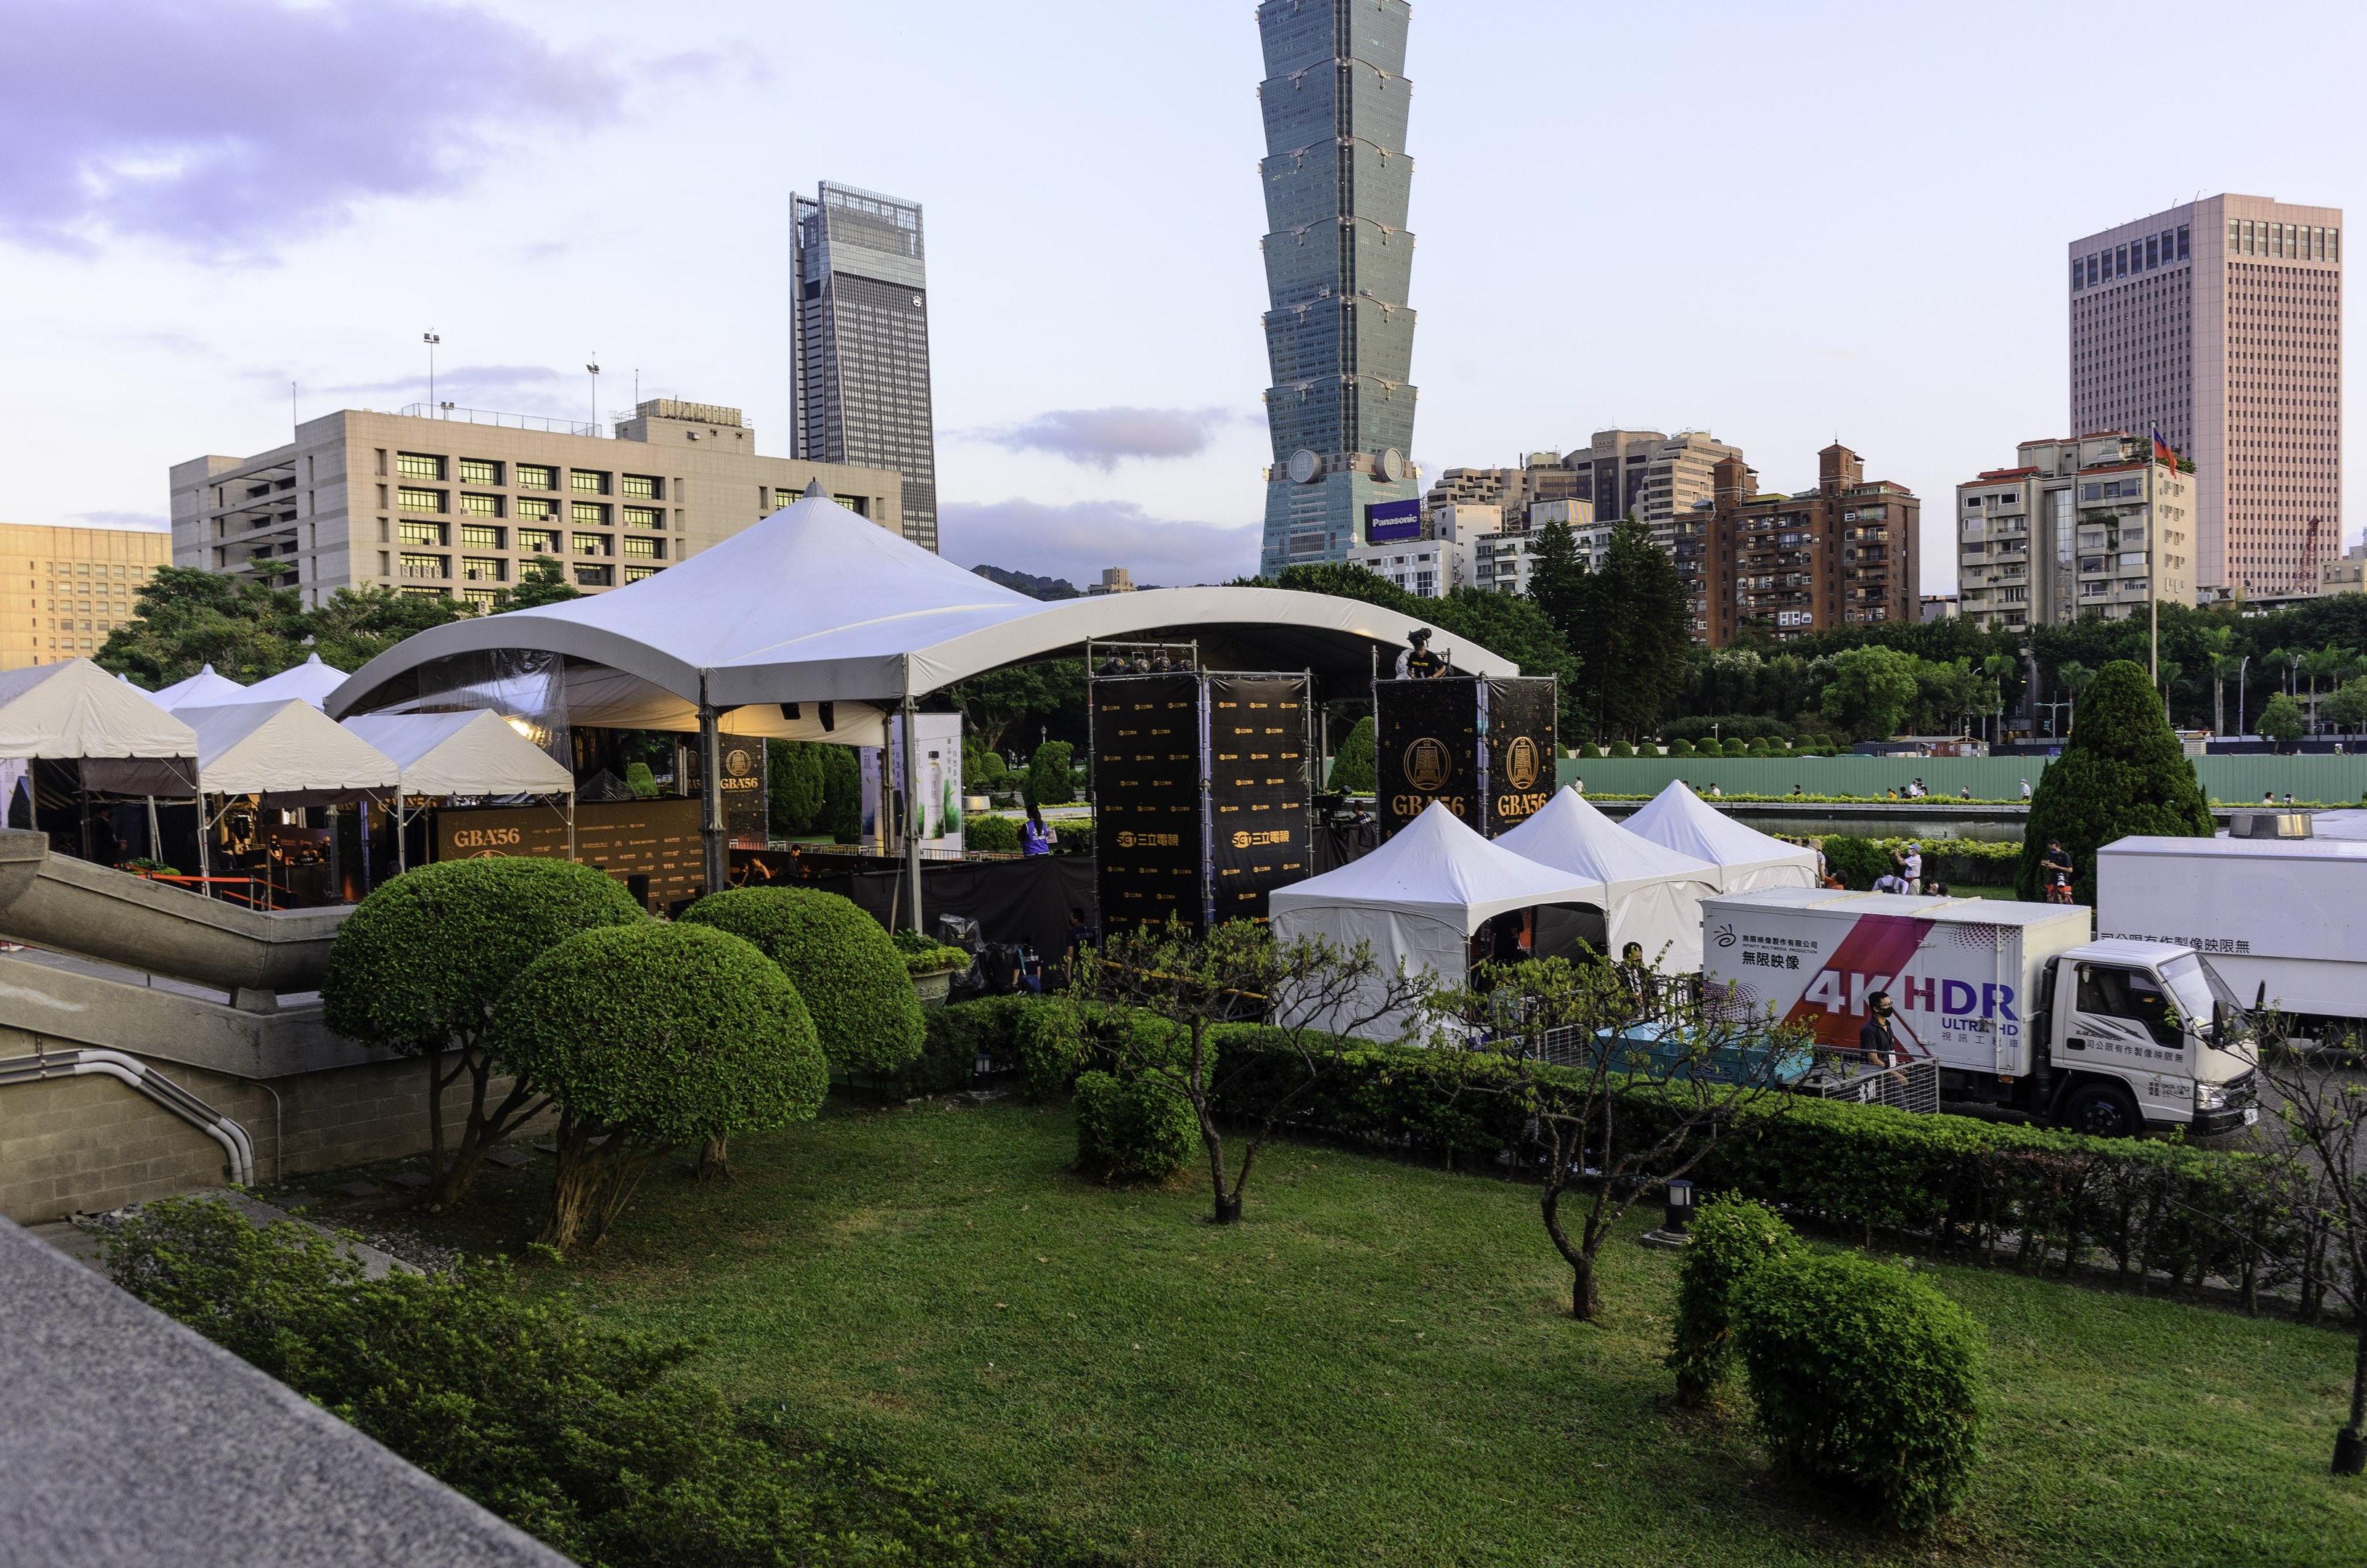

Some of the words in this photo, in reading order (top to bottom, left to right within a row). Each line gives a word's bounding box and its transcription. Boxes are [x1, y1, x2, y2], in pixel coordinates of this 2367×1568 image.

[1373, 514, 1418, 527] Panasonic
[1137, 833, 1179, 846] 三立電視
[1252, 830, 1290, 845] 三立電視
[1742, 935, 1818, 949] 無限映像製作有限公司
[1742, 951, 1799, 970] 無限映像
[1804, 970, 1892, 1016] 4K
[1905, 975, 2019, 1021] HDR
